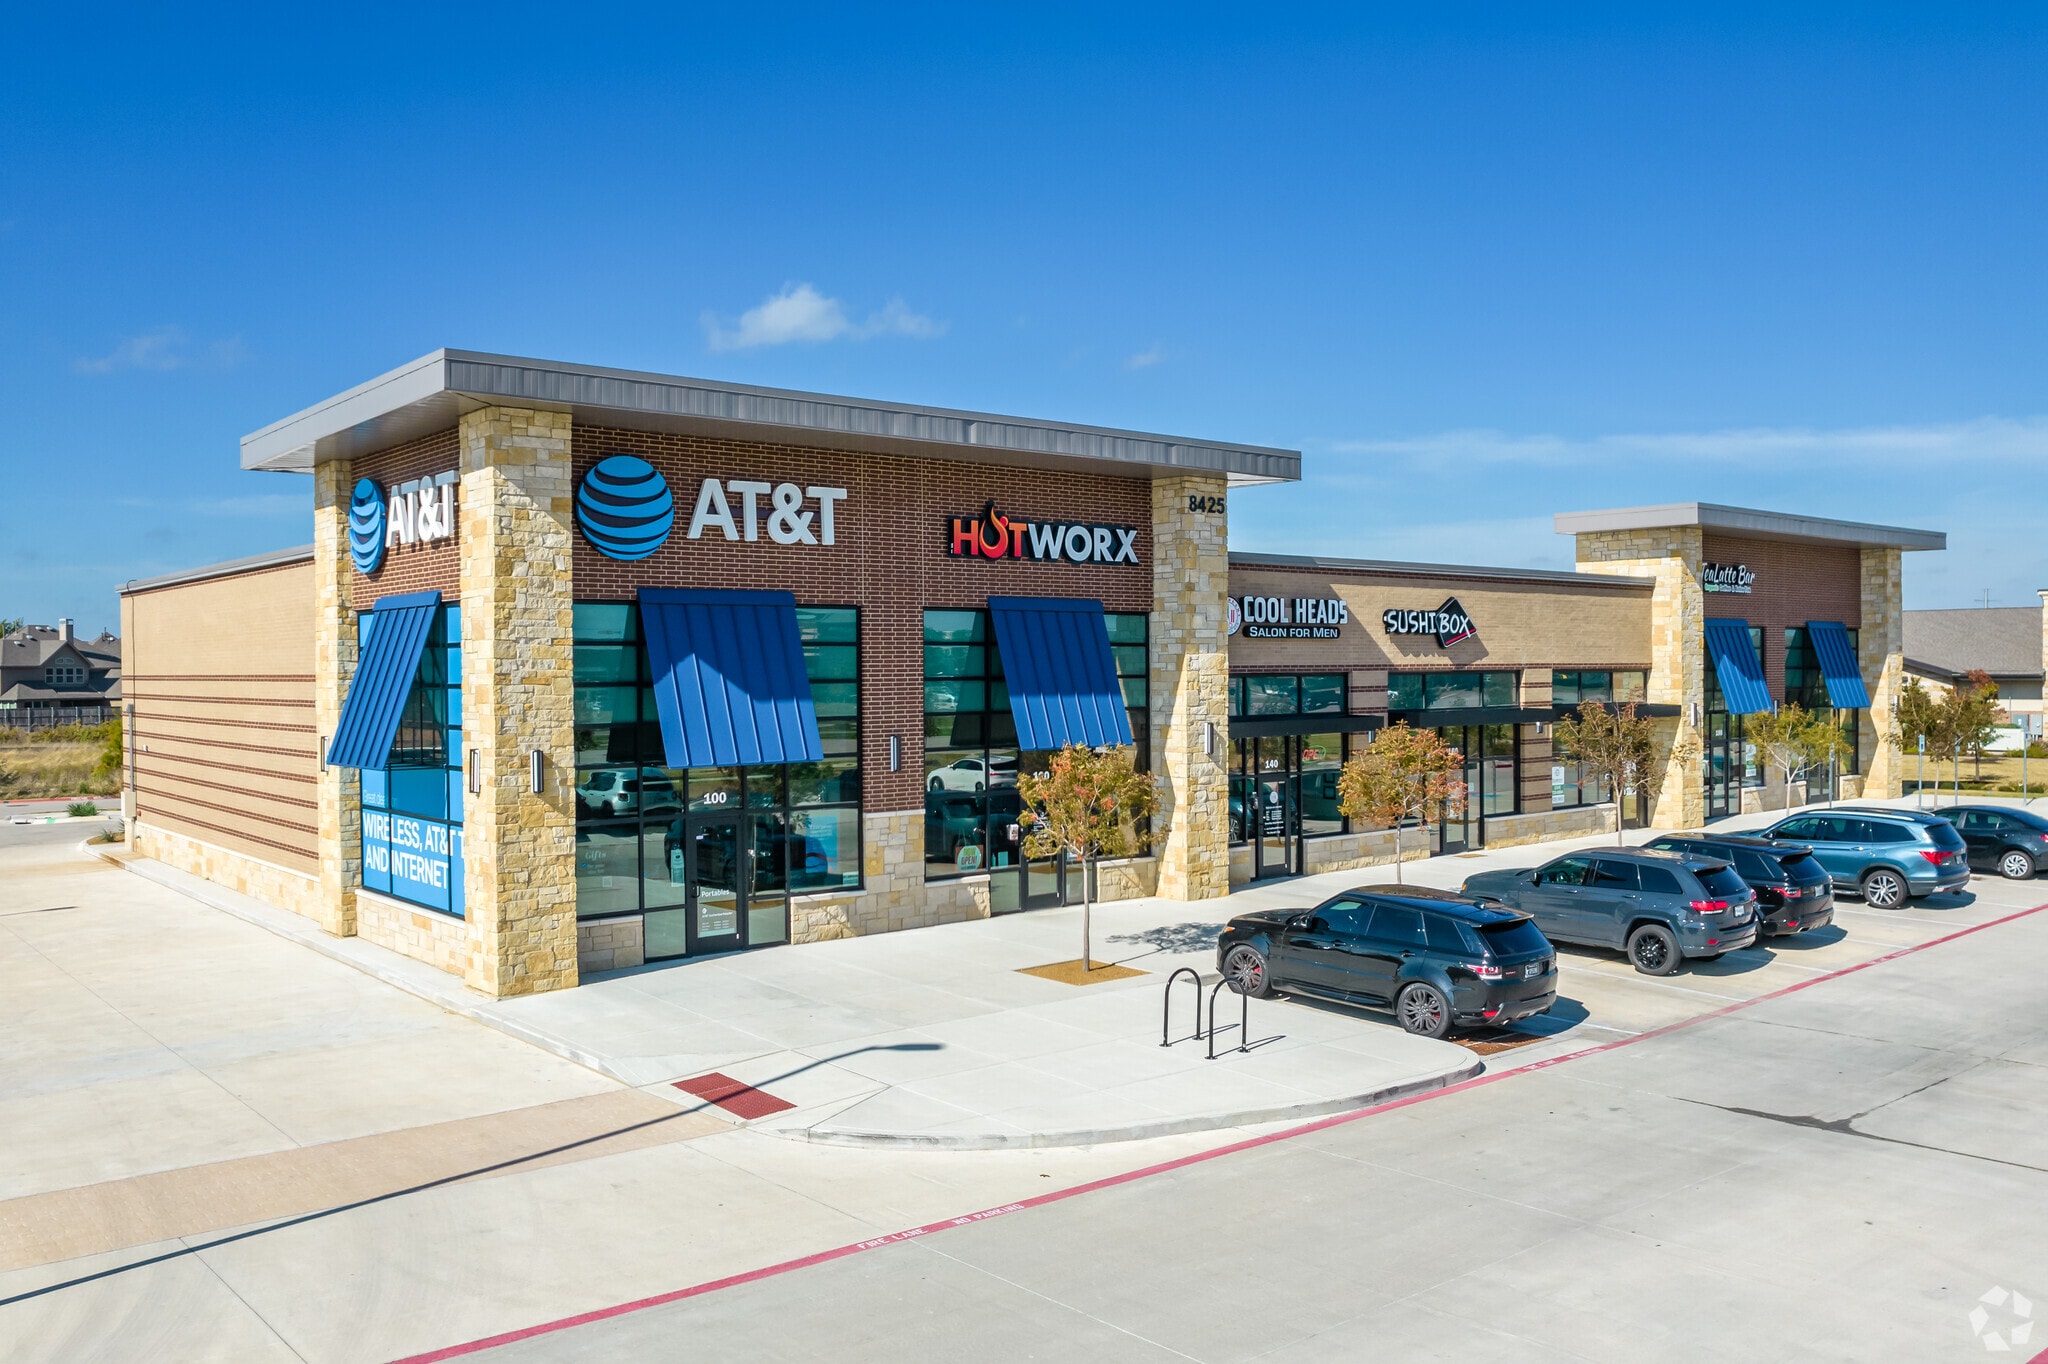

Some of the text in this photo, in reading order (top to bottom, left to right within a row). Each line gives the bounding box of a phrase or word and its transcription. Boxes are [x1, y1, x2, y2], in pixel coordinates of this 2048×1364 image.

[386, 470, 459, 548] AT&T
[686, 478, 848, 546] AT&T
[1189, 495, 1225, 514] 8425
[953, 504, 1139, 562] HOTWORX
[1738, 565, 1756, 585] Bar
[1243, 596, 1289, 623] COOL
[1295, 598, 1348, 624] HEADS
[1249, 626, 1287, 638] SALON
[1313, 627, 1338, 639] MEN
[1387, 611, 1471, 638] SUSHI BOX
[1265, 759, 1279, 769] 140
[703, 791, 727, 805] 100
[362, 812, 422, 853] WIRELESS,
[425, 824, 457, 857] AT&T
[365, 843, 449, 890] AND INTERNET
[701, 889, 730, 898] Portables
[858, 1203, 1026, 1250] FIRE LANE NO PARKING
